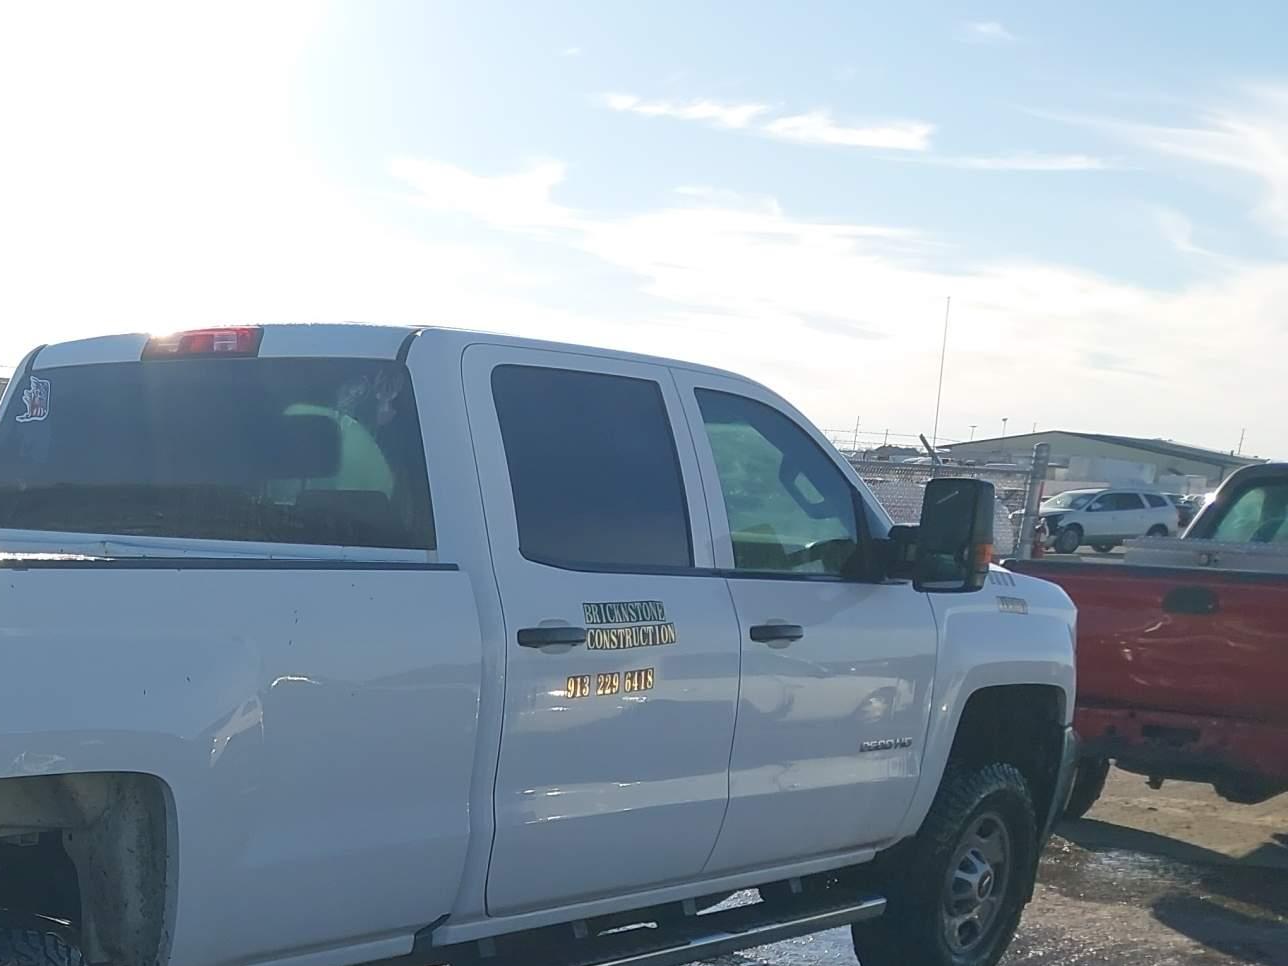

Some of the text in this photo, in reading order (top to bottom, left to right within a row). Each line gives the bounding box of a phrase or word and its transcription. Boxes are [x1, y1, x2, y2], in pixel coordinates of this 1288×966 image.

[585, 602, 666, 624] BRICKNSTONE
[587, 624, 676, 649] CONSTRUCTION
[567, 669, 654, 698] 913 229 6418
